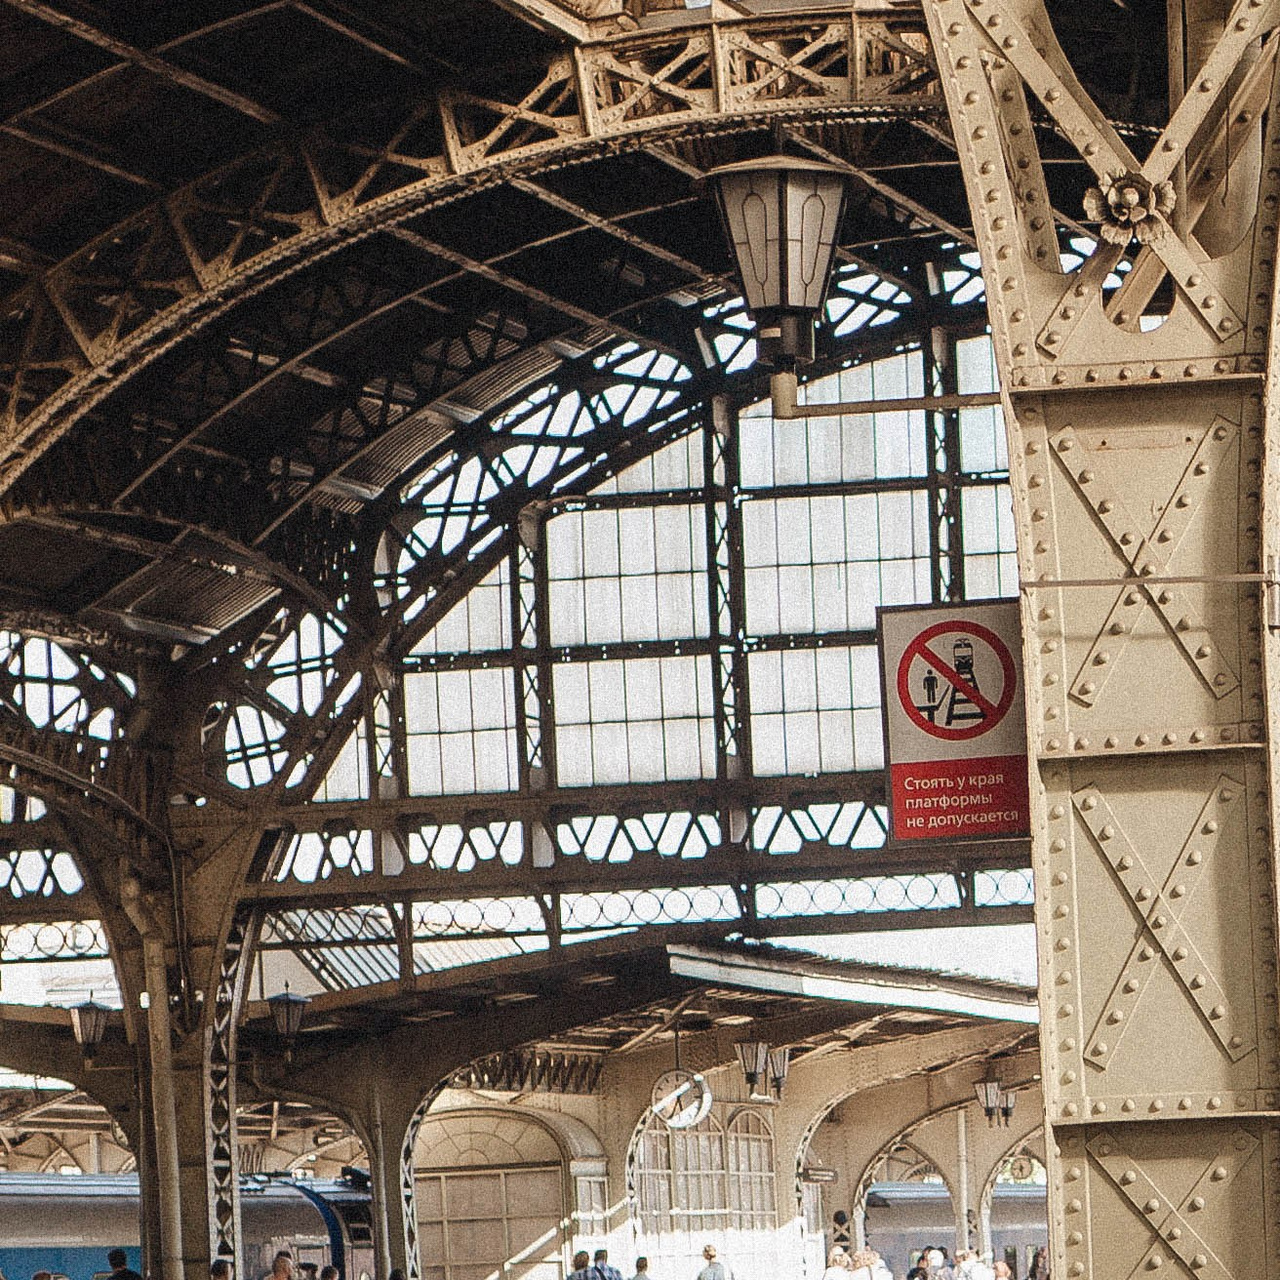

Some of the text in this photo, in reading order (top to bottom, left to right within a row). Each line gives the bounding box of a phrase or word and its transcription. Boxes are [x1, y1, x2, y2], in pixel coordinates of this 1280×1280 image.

[904, 774, 1004, 790] Стоять у края
[905, 794, 992, 810] платформы
[906, 811, 1019, 829] не допускается
